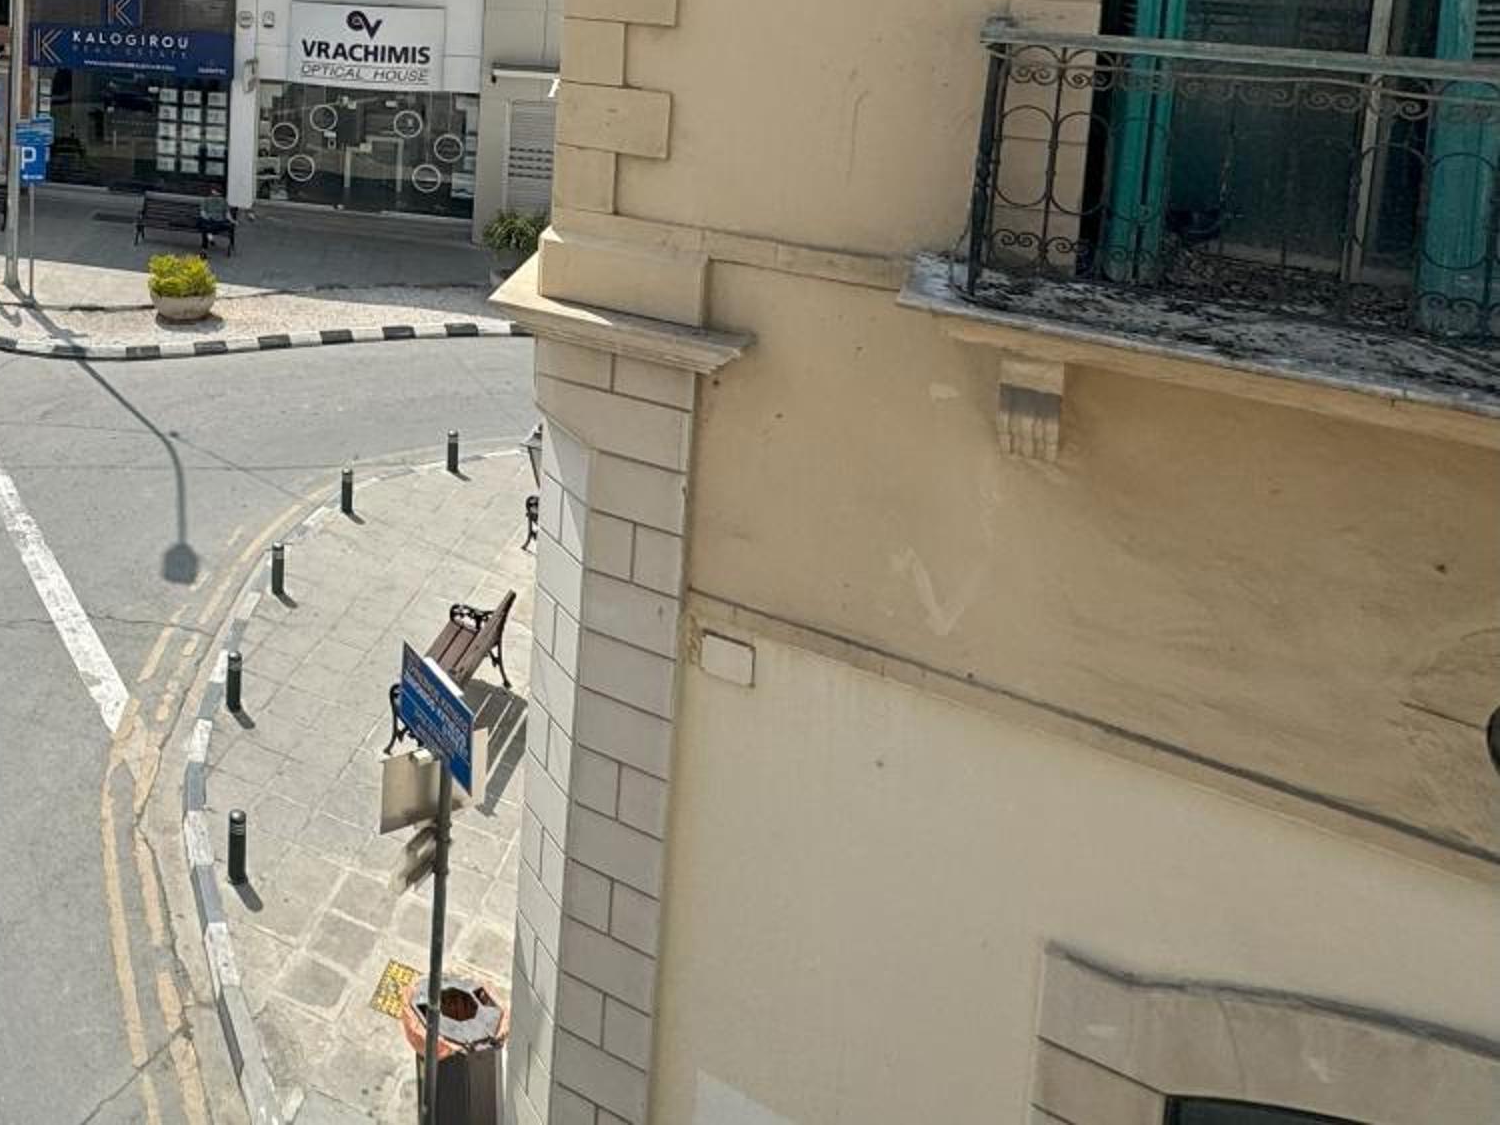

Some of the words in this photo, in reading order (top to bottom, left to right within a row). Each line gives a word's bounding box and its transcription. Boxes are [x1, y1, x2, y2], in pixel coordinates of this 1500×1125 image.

[72, 30, 189, 50] KALOGIROU
[302, 39, 431, 65] VRACHIMIS
[301, 63, 364, 81] OPTICAL
[373, 67, 430, 82] HOUSE
[21, 146, 37, 171] P
